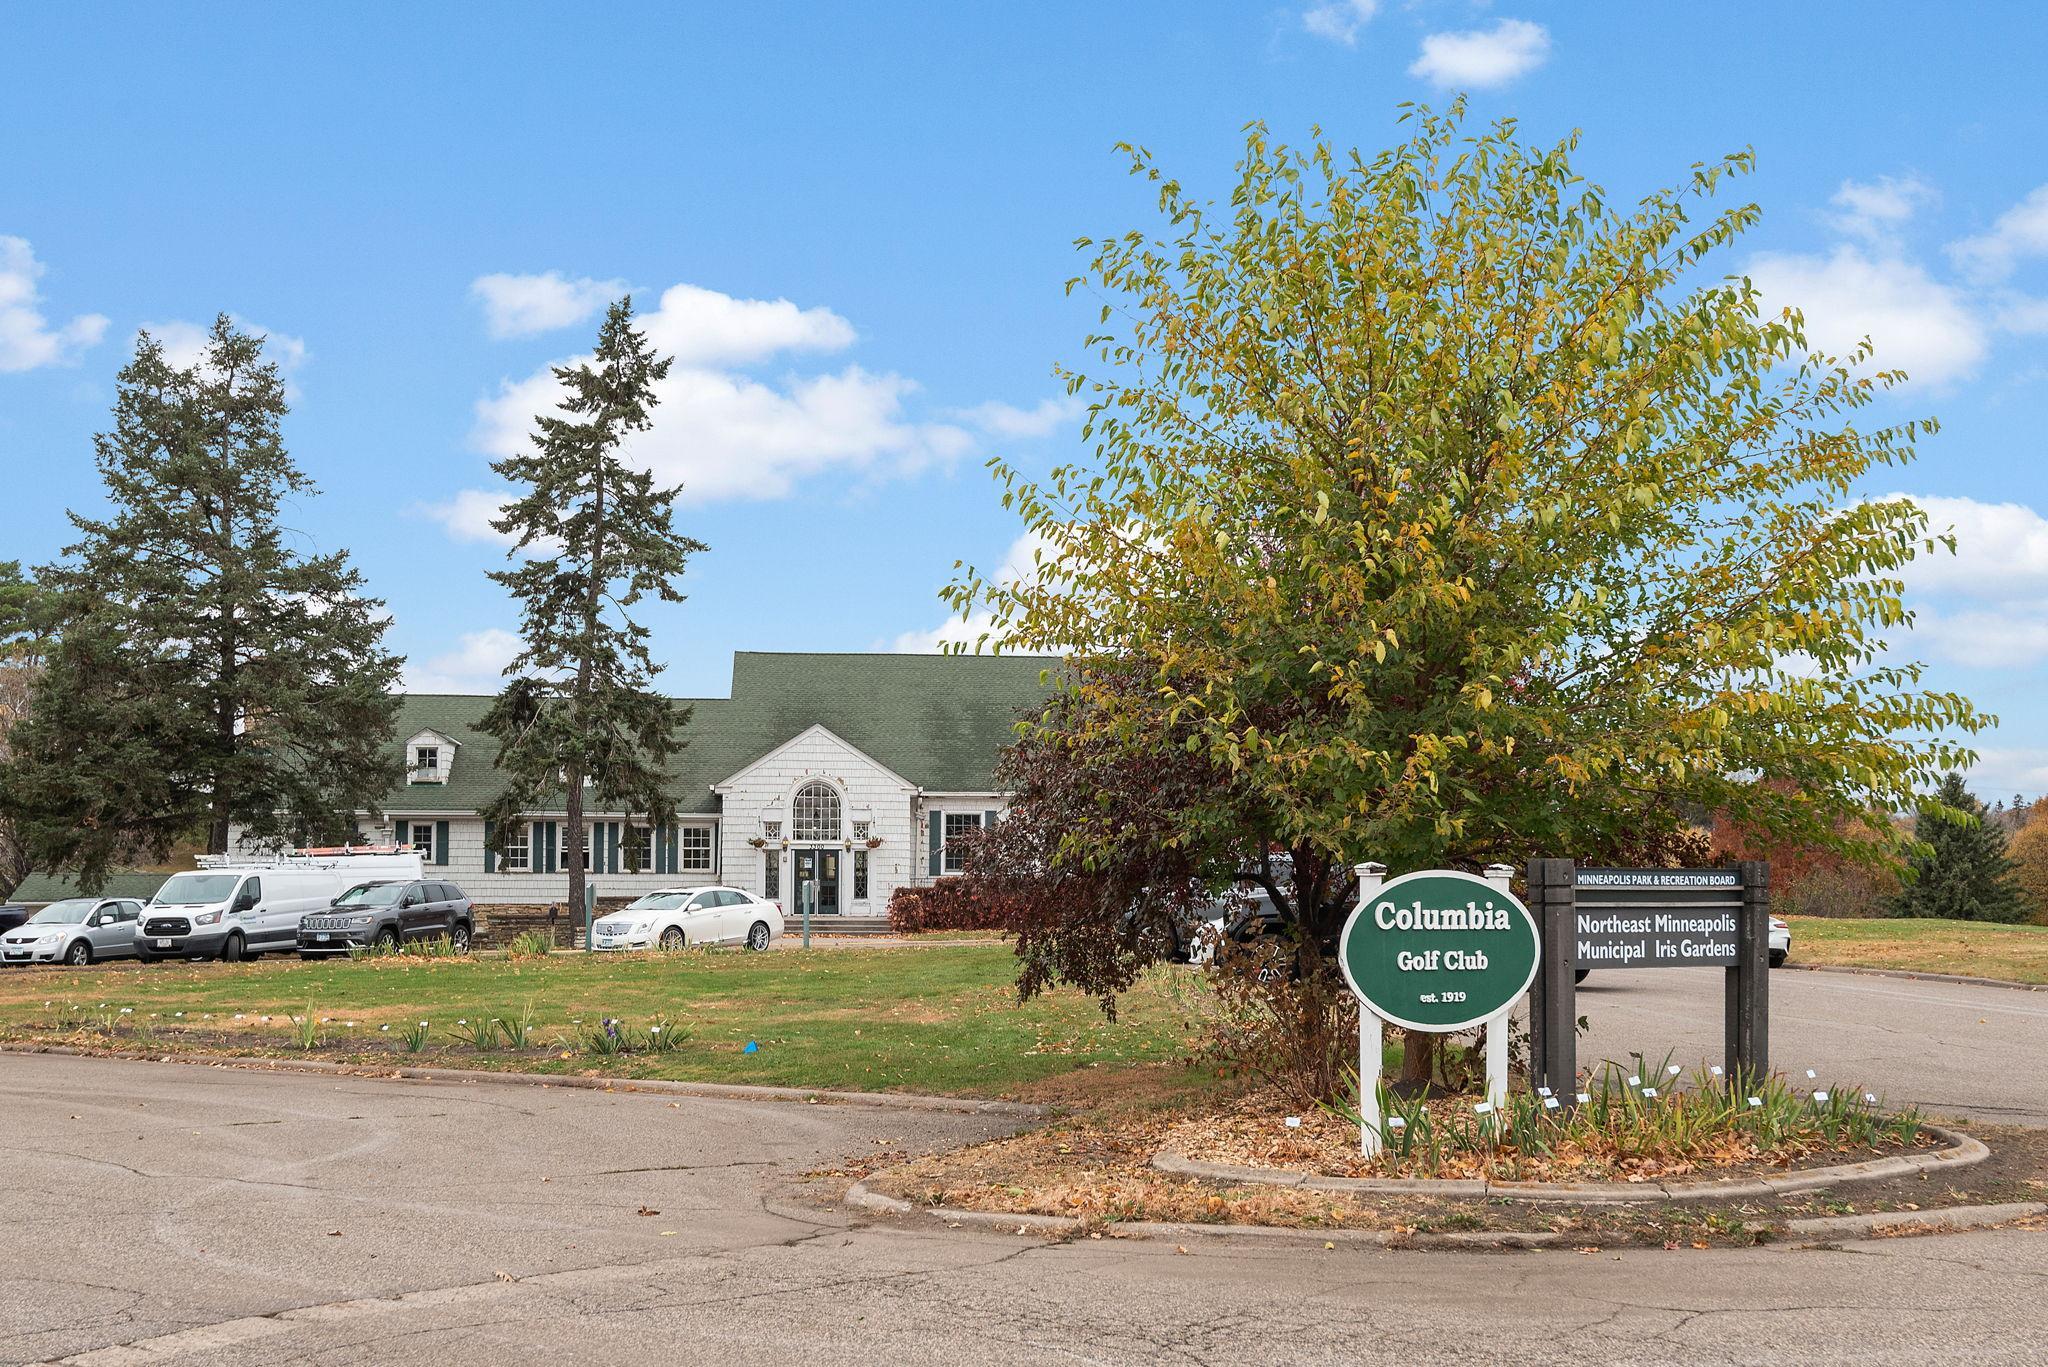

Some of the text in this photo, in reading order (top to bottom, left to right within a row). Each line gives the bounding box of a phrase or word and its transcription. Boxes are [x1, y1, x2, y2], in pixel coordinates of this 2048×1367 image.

[1577, 874, 1736, 886] MINNEAPOLIS PARK & RECREATION BOARD
[1374, 901, 1511, 931] Columbia
[1577, 913, 1736, 938] Northeast Minneapolis
[1397, 950, 1489, 971] Golf Club
[1577, 939, 1736, 964] Municipal Iris Gardens
[1419, 991, 1467, 1003] est. 1919
